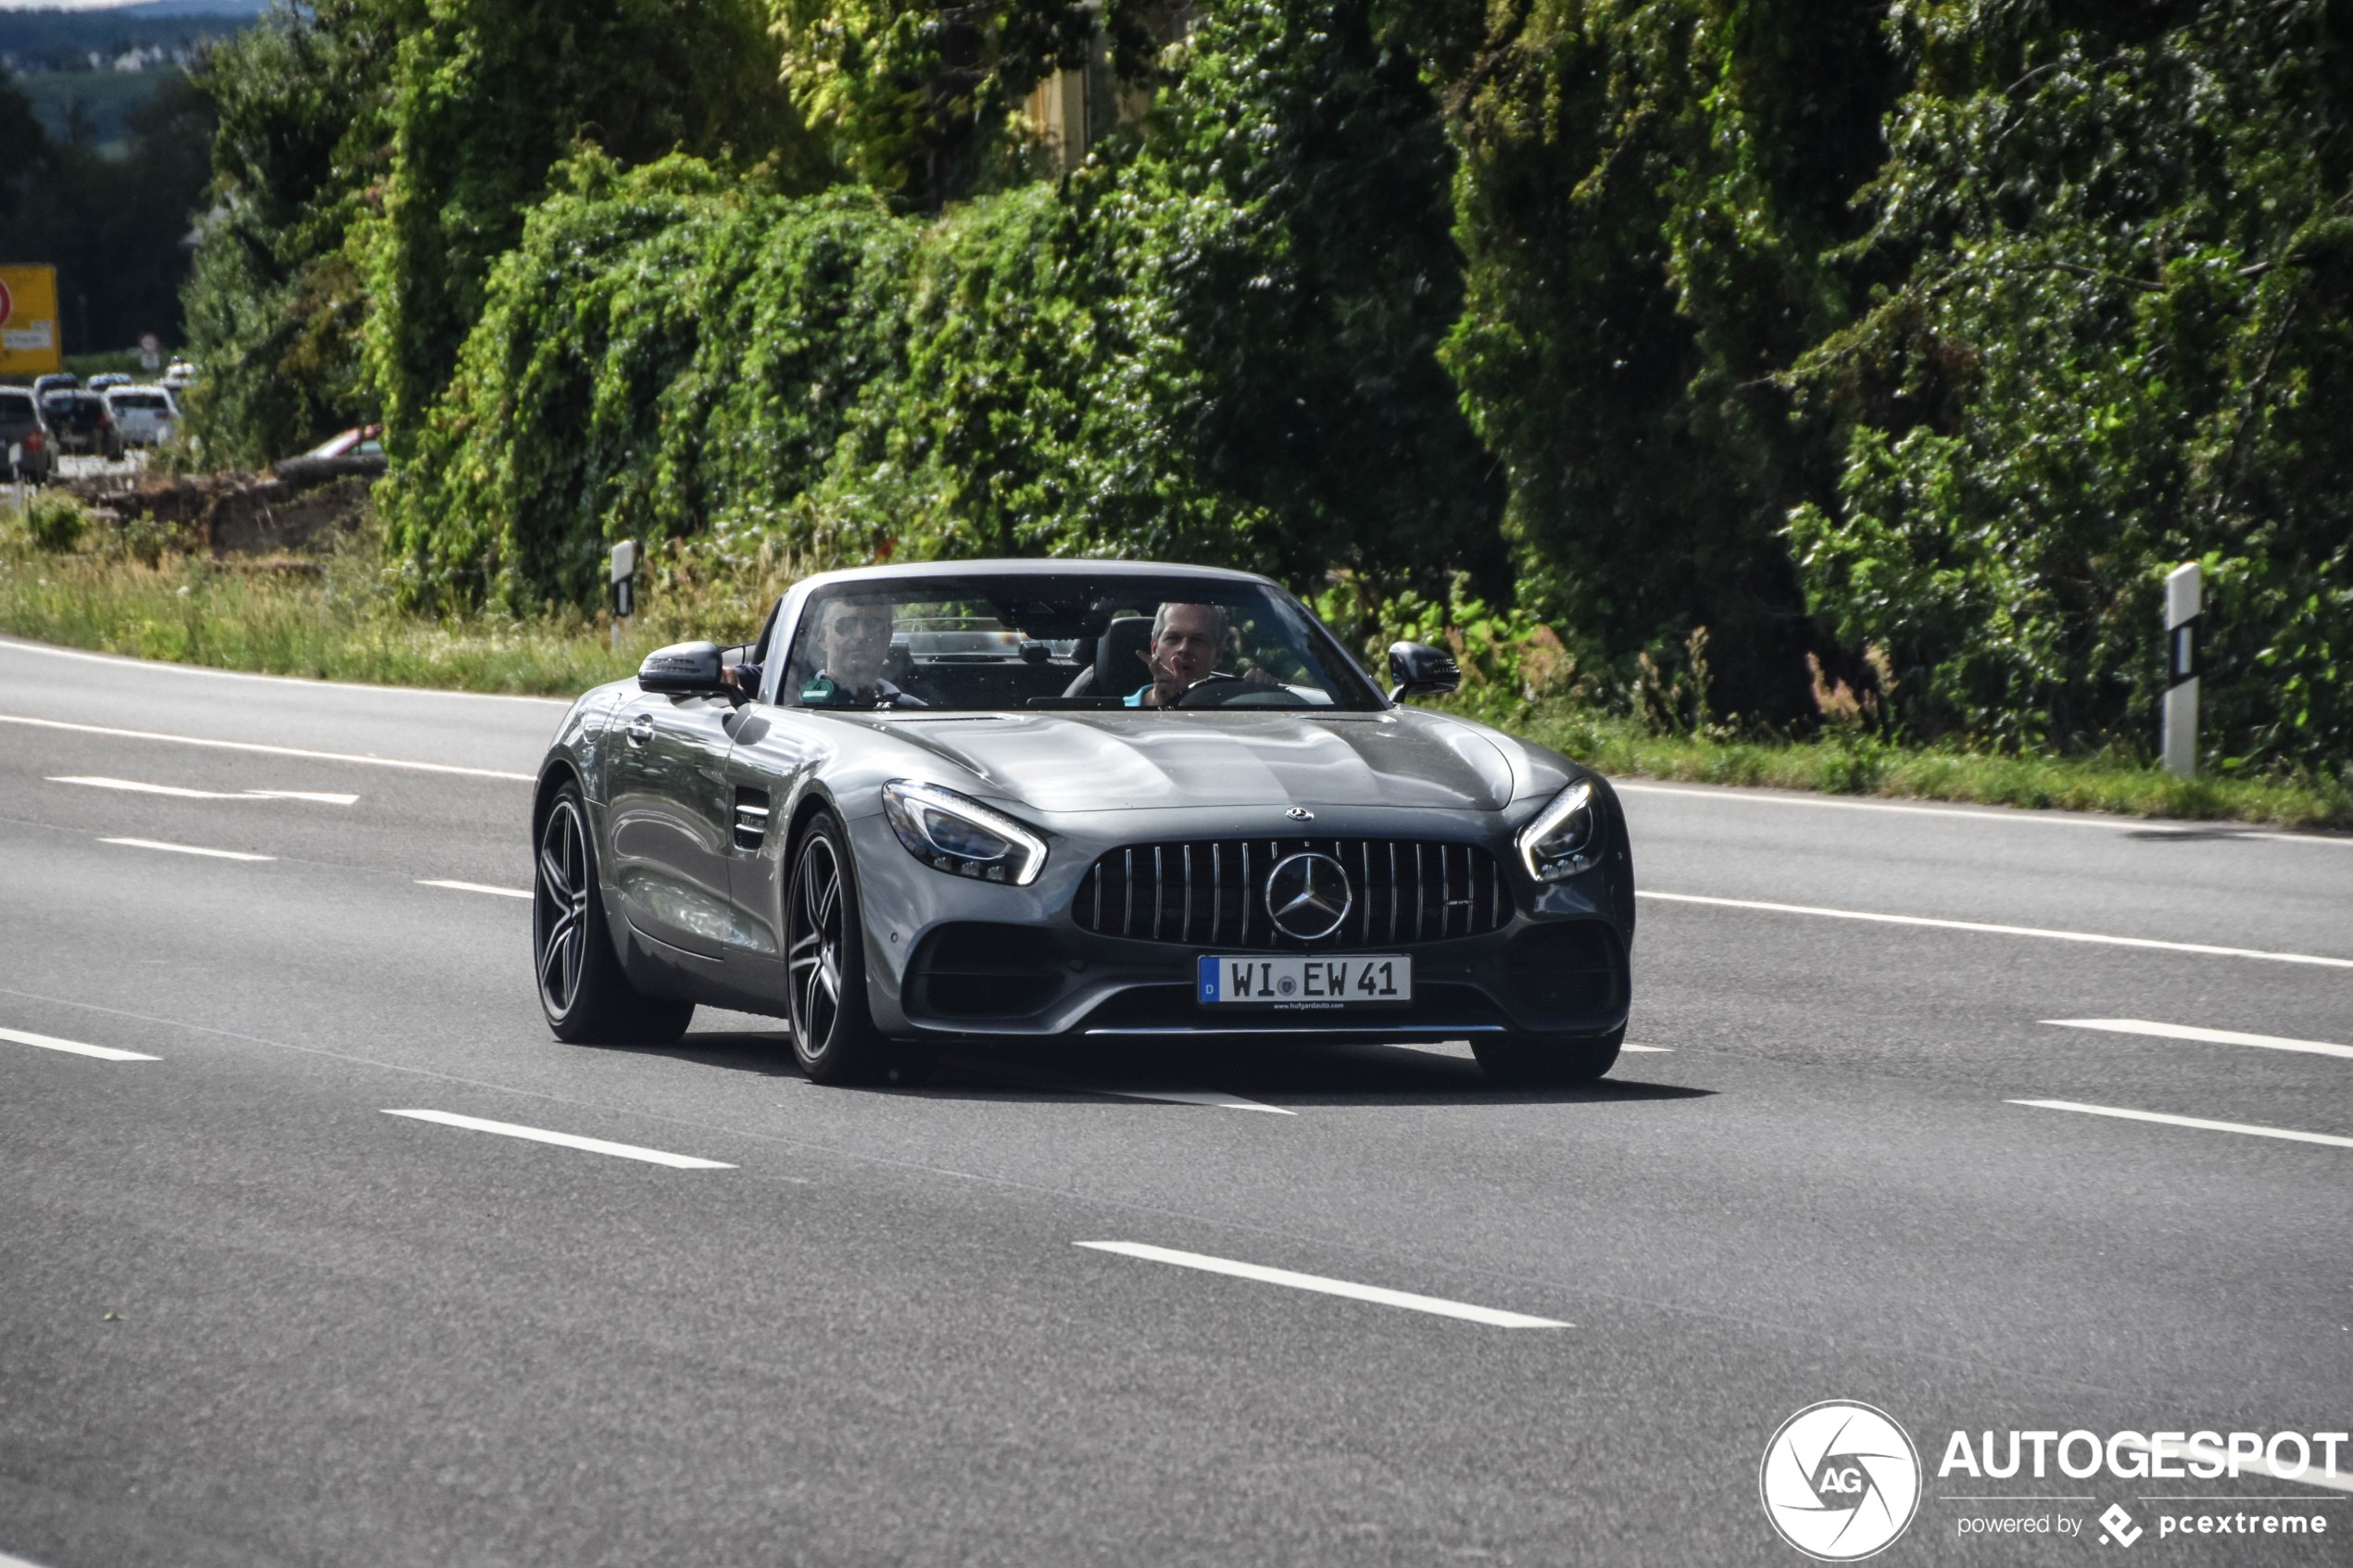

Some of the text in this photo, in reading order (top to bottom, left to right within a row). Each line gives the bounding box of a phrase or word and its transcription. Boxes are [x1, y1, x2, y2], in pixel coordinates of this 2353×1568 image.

[812, 681, 822, 691] 4
[1231, 961, 1398, 997] WI EW 41
[1206, 985, 1214, 994] D
